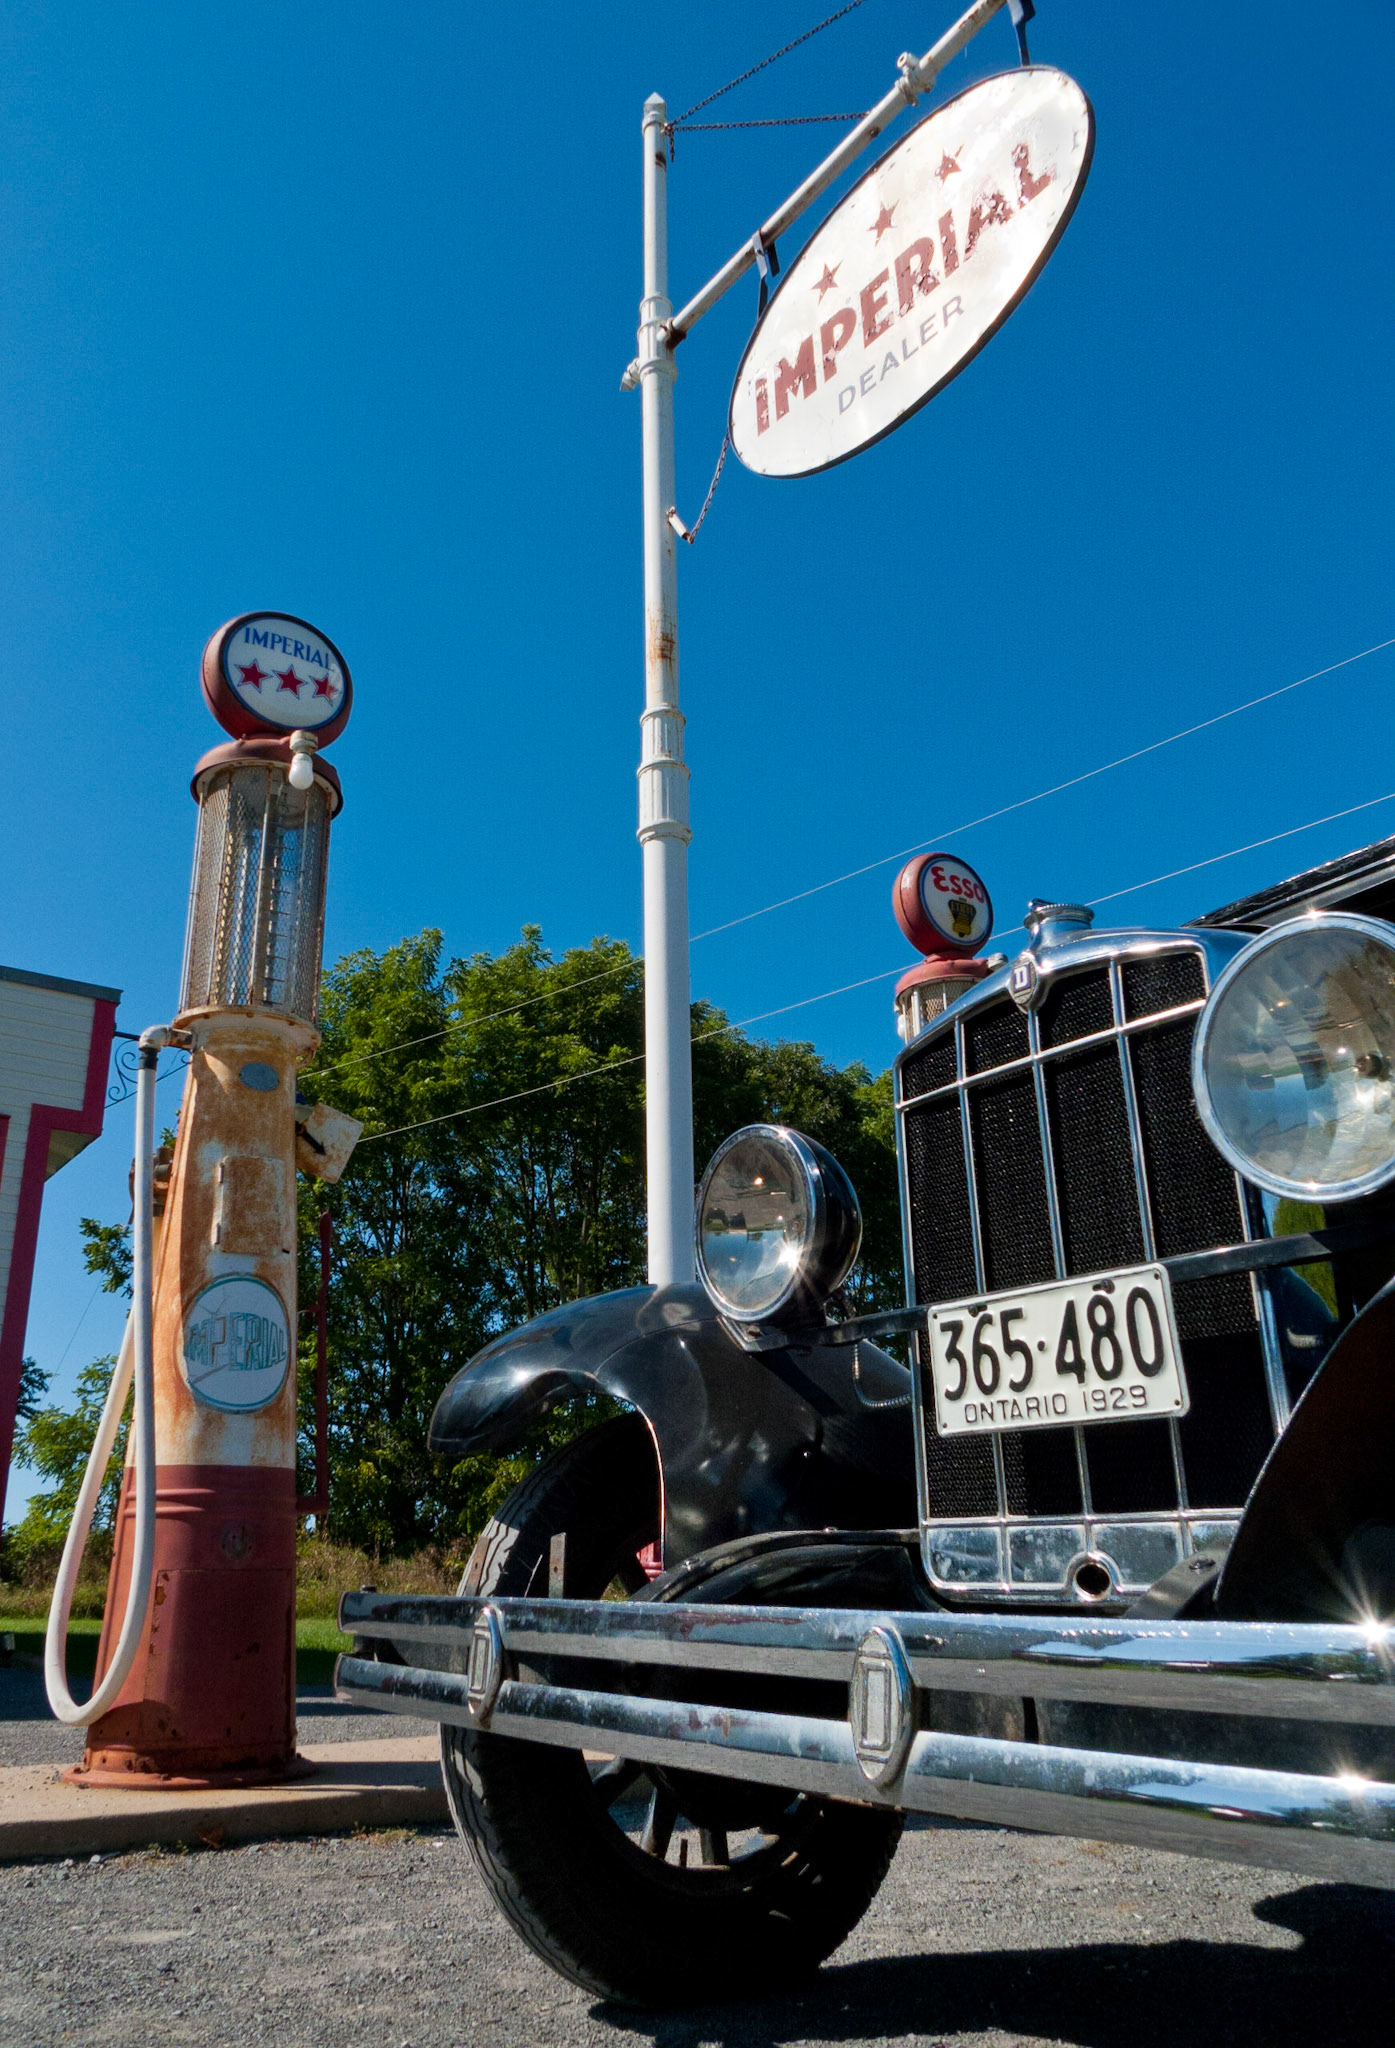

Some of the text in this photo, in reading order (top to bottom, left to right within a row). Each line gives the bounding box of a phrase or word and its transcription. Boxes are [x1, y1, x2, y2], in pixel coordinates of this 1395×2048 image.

[755, 142, 1057, 437] IMPERIAL
[838, 295, 965, 415] DEALER
[243, 627, 334, 672] IMPERIAL
[964, 1385, 1148, 1424] ONTARIO 1929
